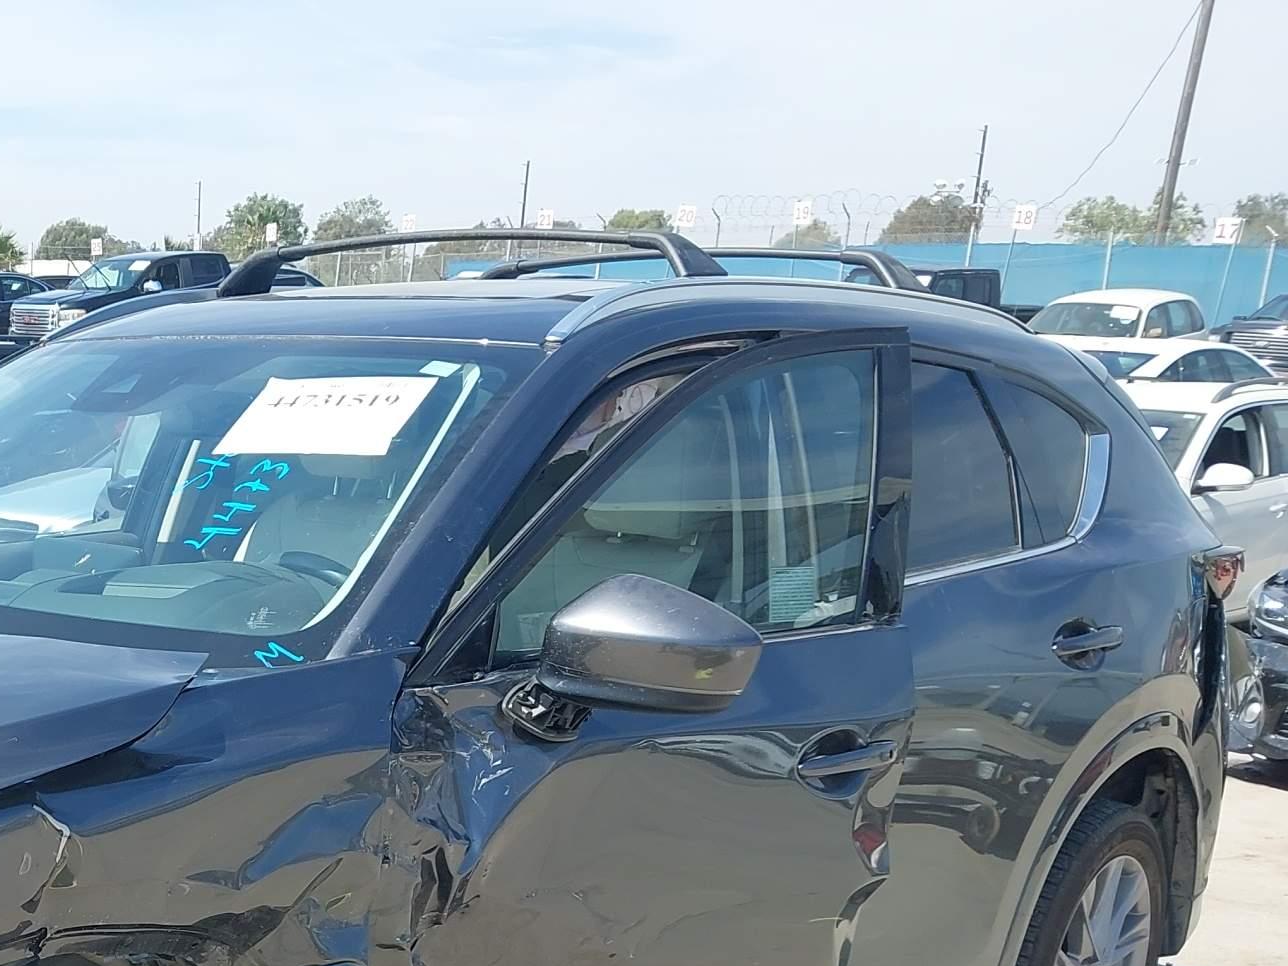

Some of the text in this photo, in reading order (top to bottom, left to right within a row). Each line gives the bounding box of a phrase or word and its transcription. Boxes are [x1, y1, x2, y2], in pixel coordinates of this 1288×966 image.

[539, 214, 552, 226] 21
[678, 208, 694, 223] 20
[795, 206, 810, 221] 19
[1015, 210, 1033, 224] 18
[1215, 223, 1240, 238] 17
[267, 393, 400, 408] 44731519
